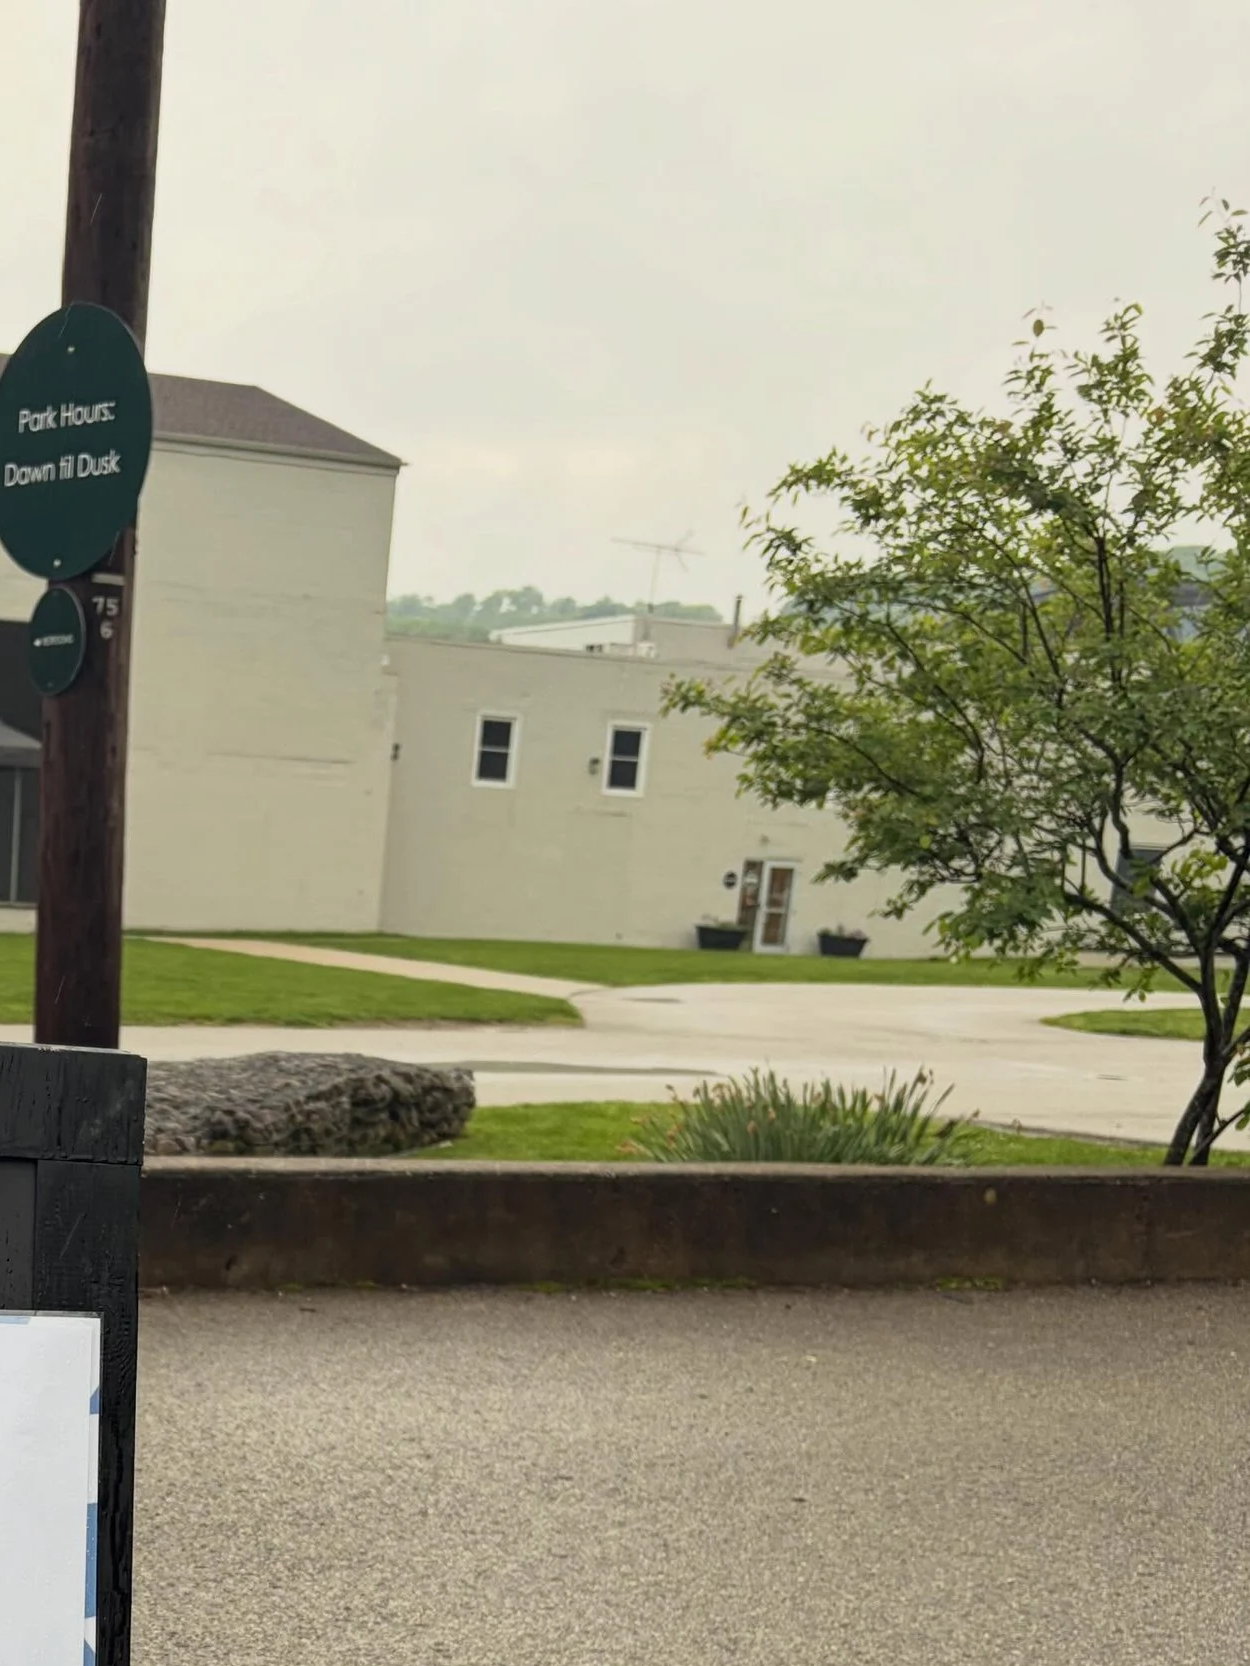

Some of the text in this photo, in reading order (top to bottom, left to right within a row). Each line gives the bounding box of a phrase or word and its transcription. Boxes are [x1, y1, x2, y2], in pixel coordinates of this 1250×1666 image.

[18, 401, 116, 433] Park Hours:
[3, 449, 121, 487] Dawn til Dusk
[91, 596, 119, 616] 75
